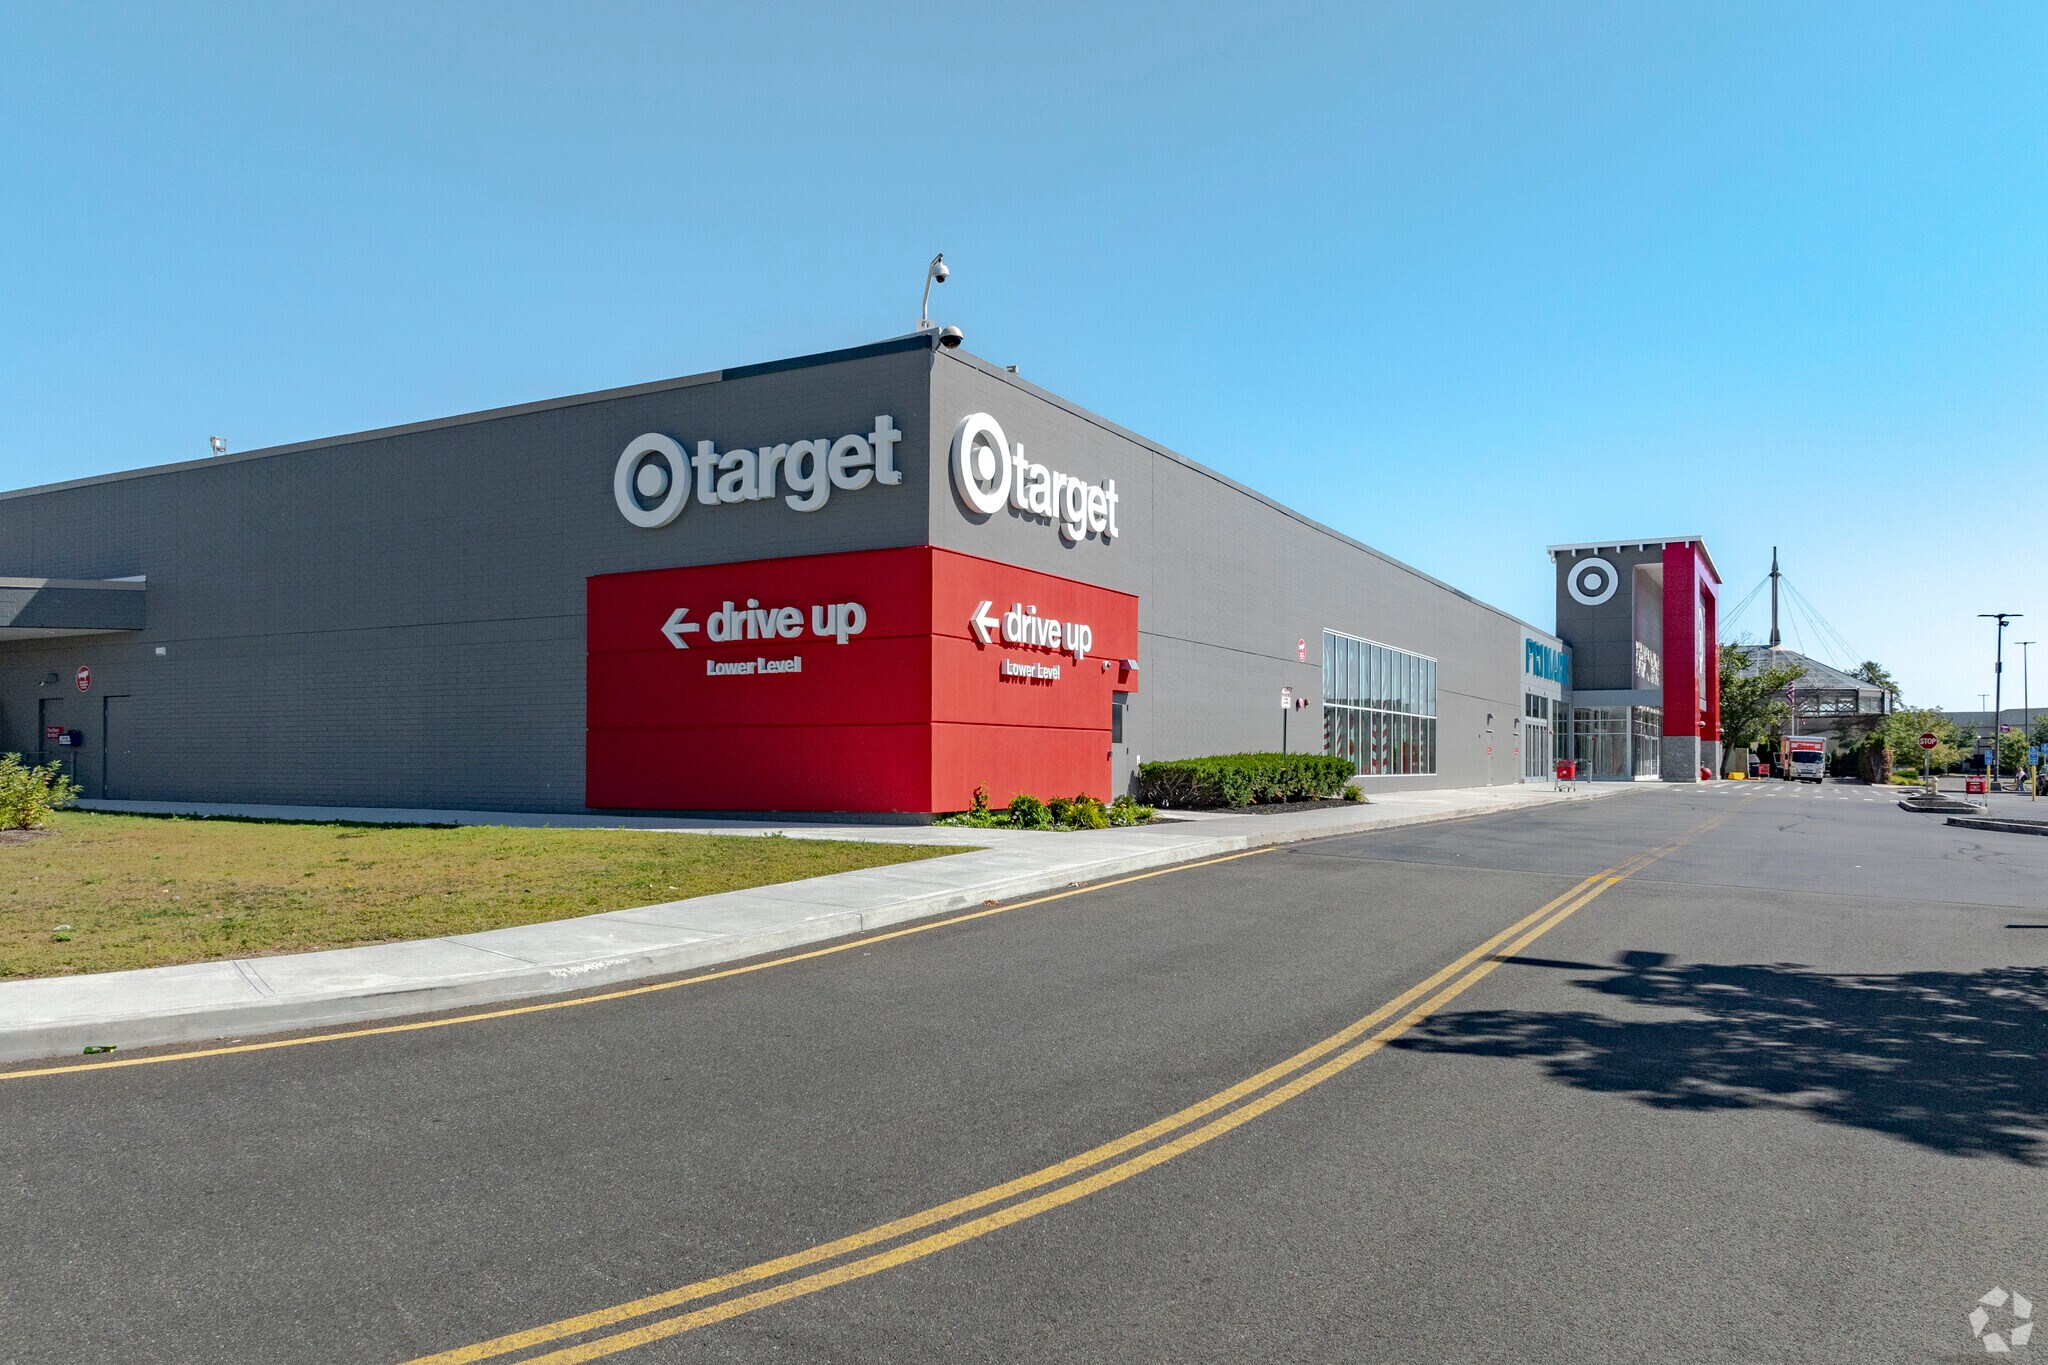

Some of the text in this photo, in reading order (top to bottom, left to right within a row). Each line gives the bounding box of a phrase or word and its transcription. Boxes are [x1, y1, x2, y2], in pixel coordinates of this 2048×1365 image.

[691, 415, 903, 512] target
[1010, 442, 1119, 541] target
[707, 598, 867, 645] drive up
[1002, 602, 1092, 660] drive up
[706, 656, 802, 676] Lower Level
[1003, 659, 1060, 680] Lower Level
